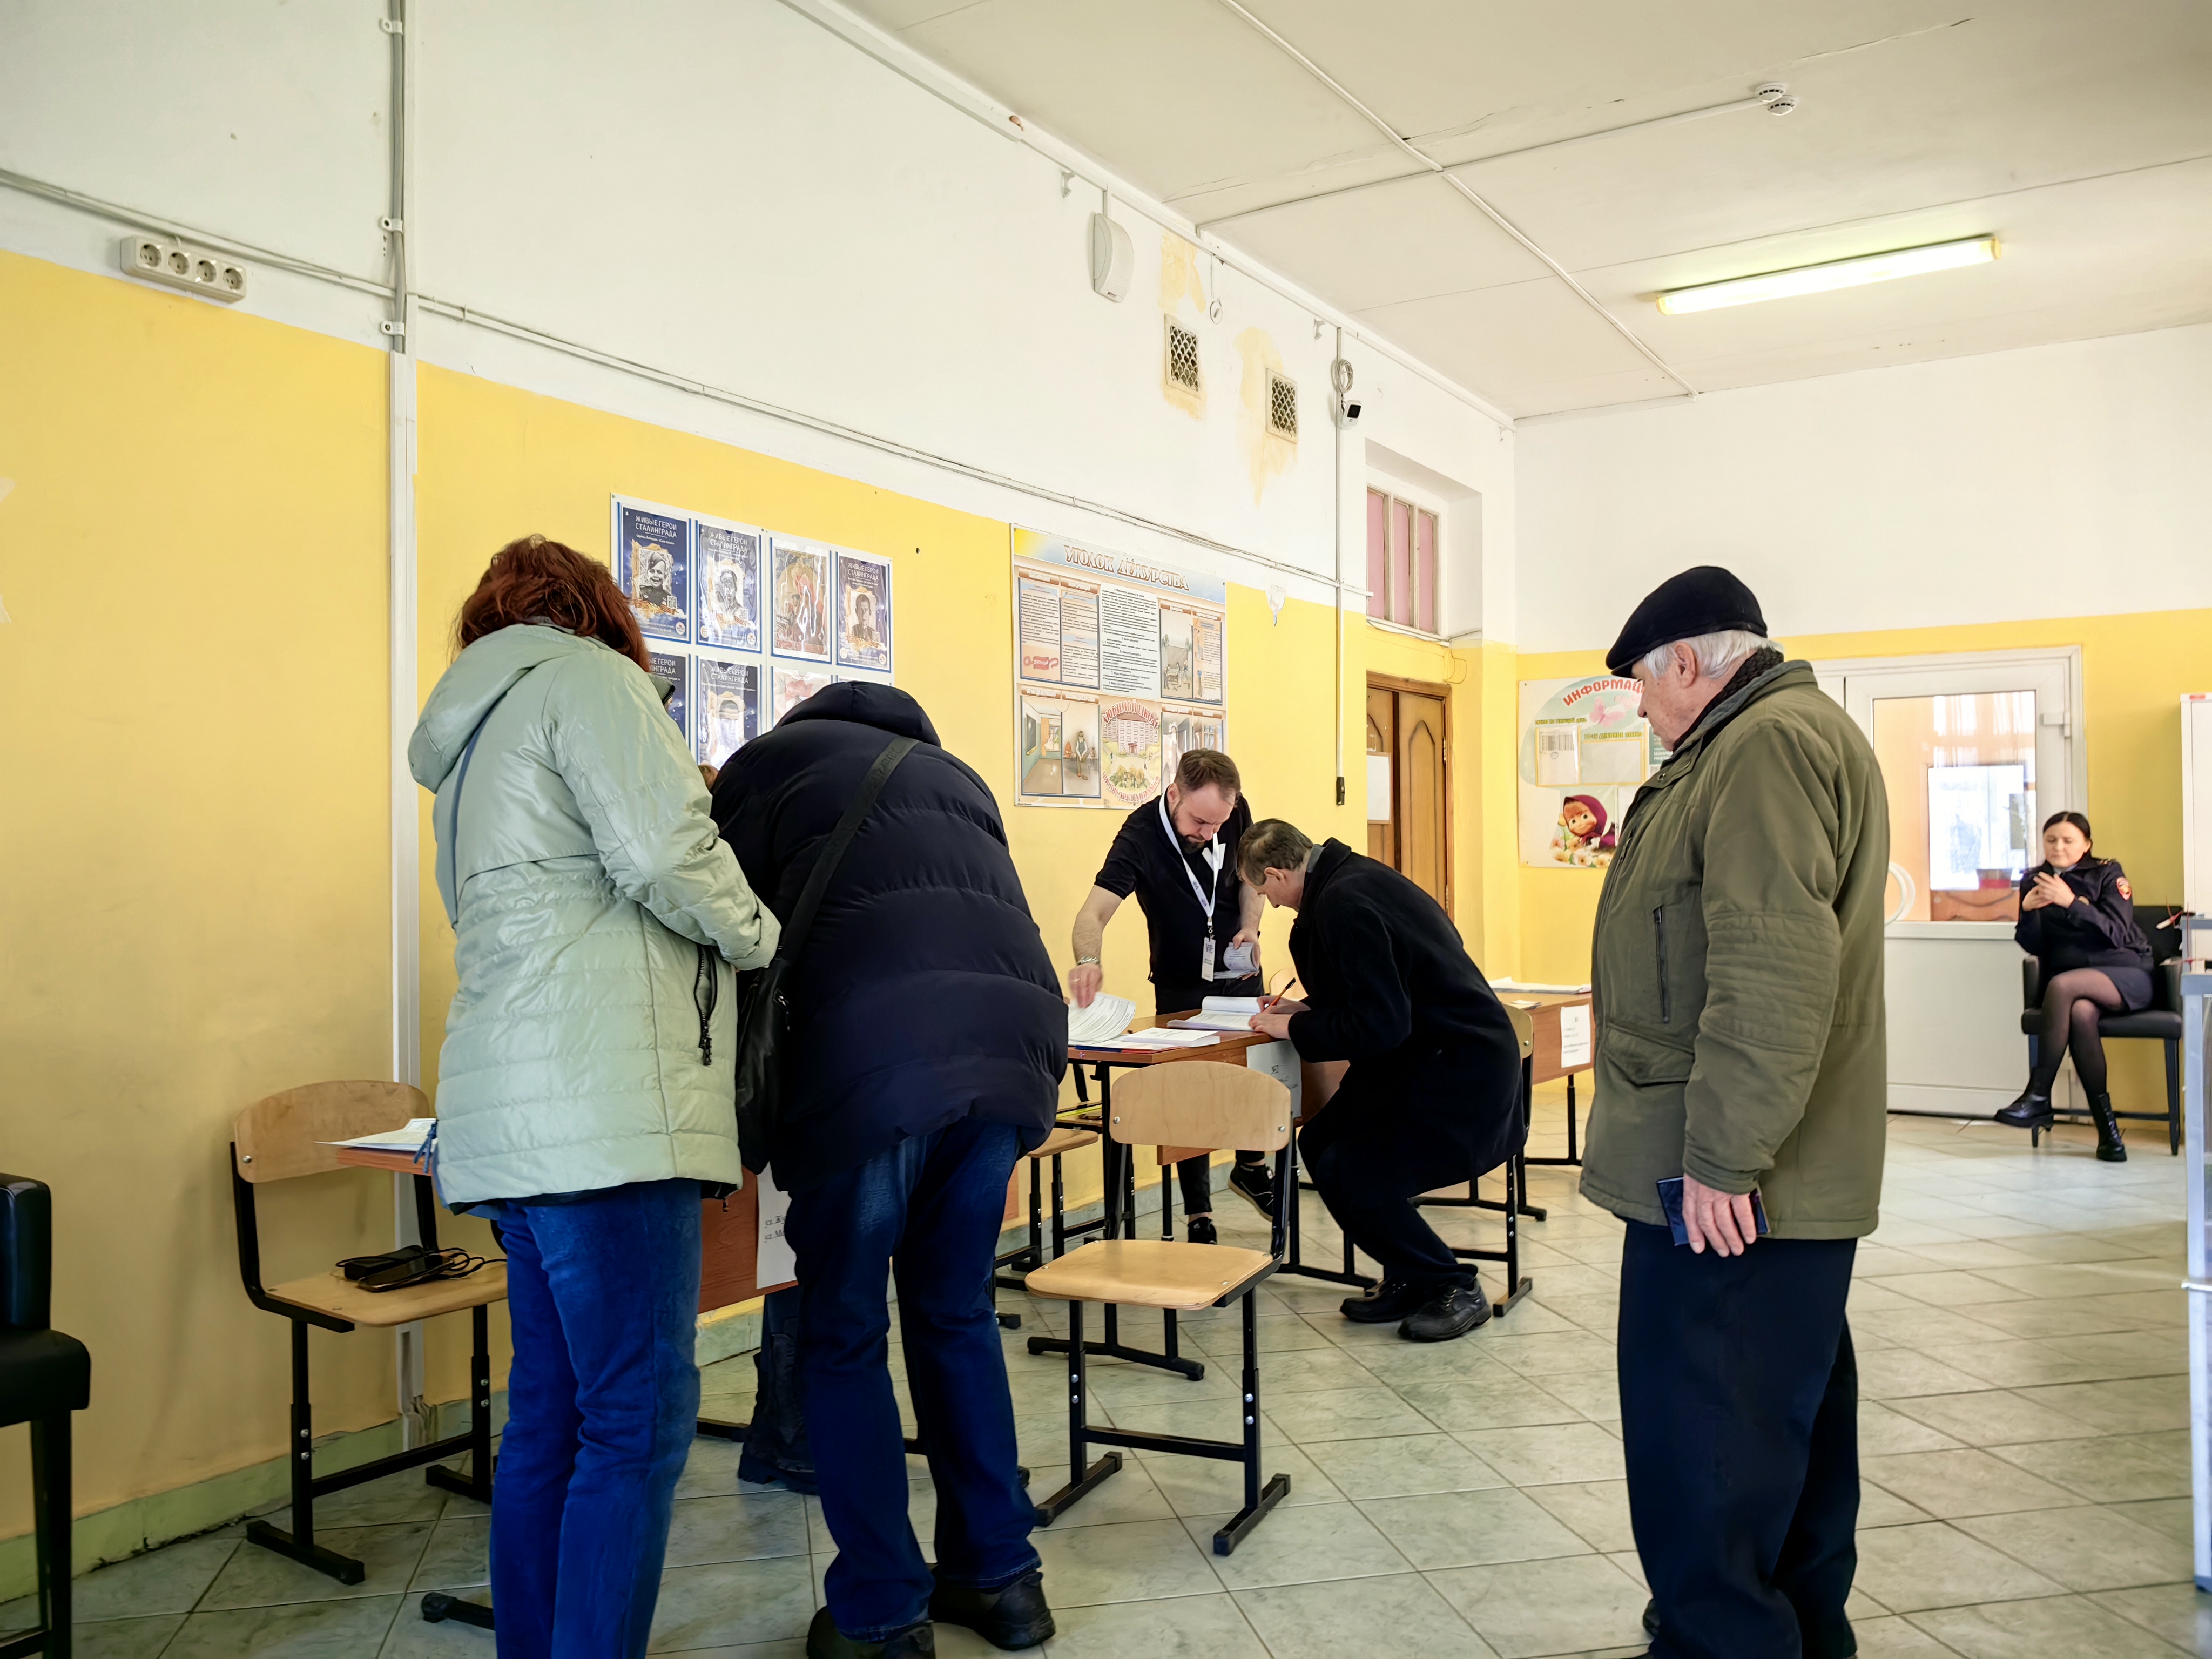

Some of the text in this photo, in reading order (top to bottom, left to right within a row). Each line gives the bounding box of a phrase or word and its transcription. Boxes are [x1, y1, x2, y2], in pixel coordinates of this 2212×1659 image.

[636, 515, 677, 531] ЖИВЫЕ ГЕРОИ
[635, 523, 677, 538] СТАЛИНГРАДА
[710, 532, 747, 545] ЖИВЫЕ ГЕРОИ
[710, 539, 747, 554] СТАЛИНГРАДА
[848, 562, 878, 575] ЖИВЫЕ ГЕРОИ
[1064, 544, 1189, 591] УГОЛОК ДЕЖУРСТВА
[848, 569, 878, 581] СТАЛИНГРАДА
[658, 658, 676, 667] ГЕРОИ
[711, 673, 748, 684] СТАЛИНГРАДА
[713, 666, 748, 677] ЖИВЫЕ ГЕРОИ
[1563, 679, 1645, 706] ИНФОРМАЦ
[1103, 699, 1137, 724] ЛЮБИМОЙ
